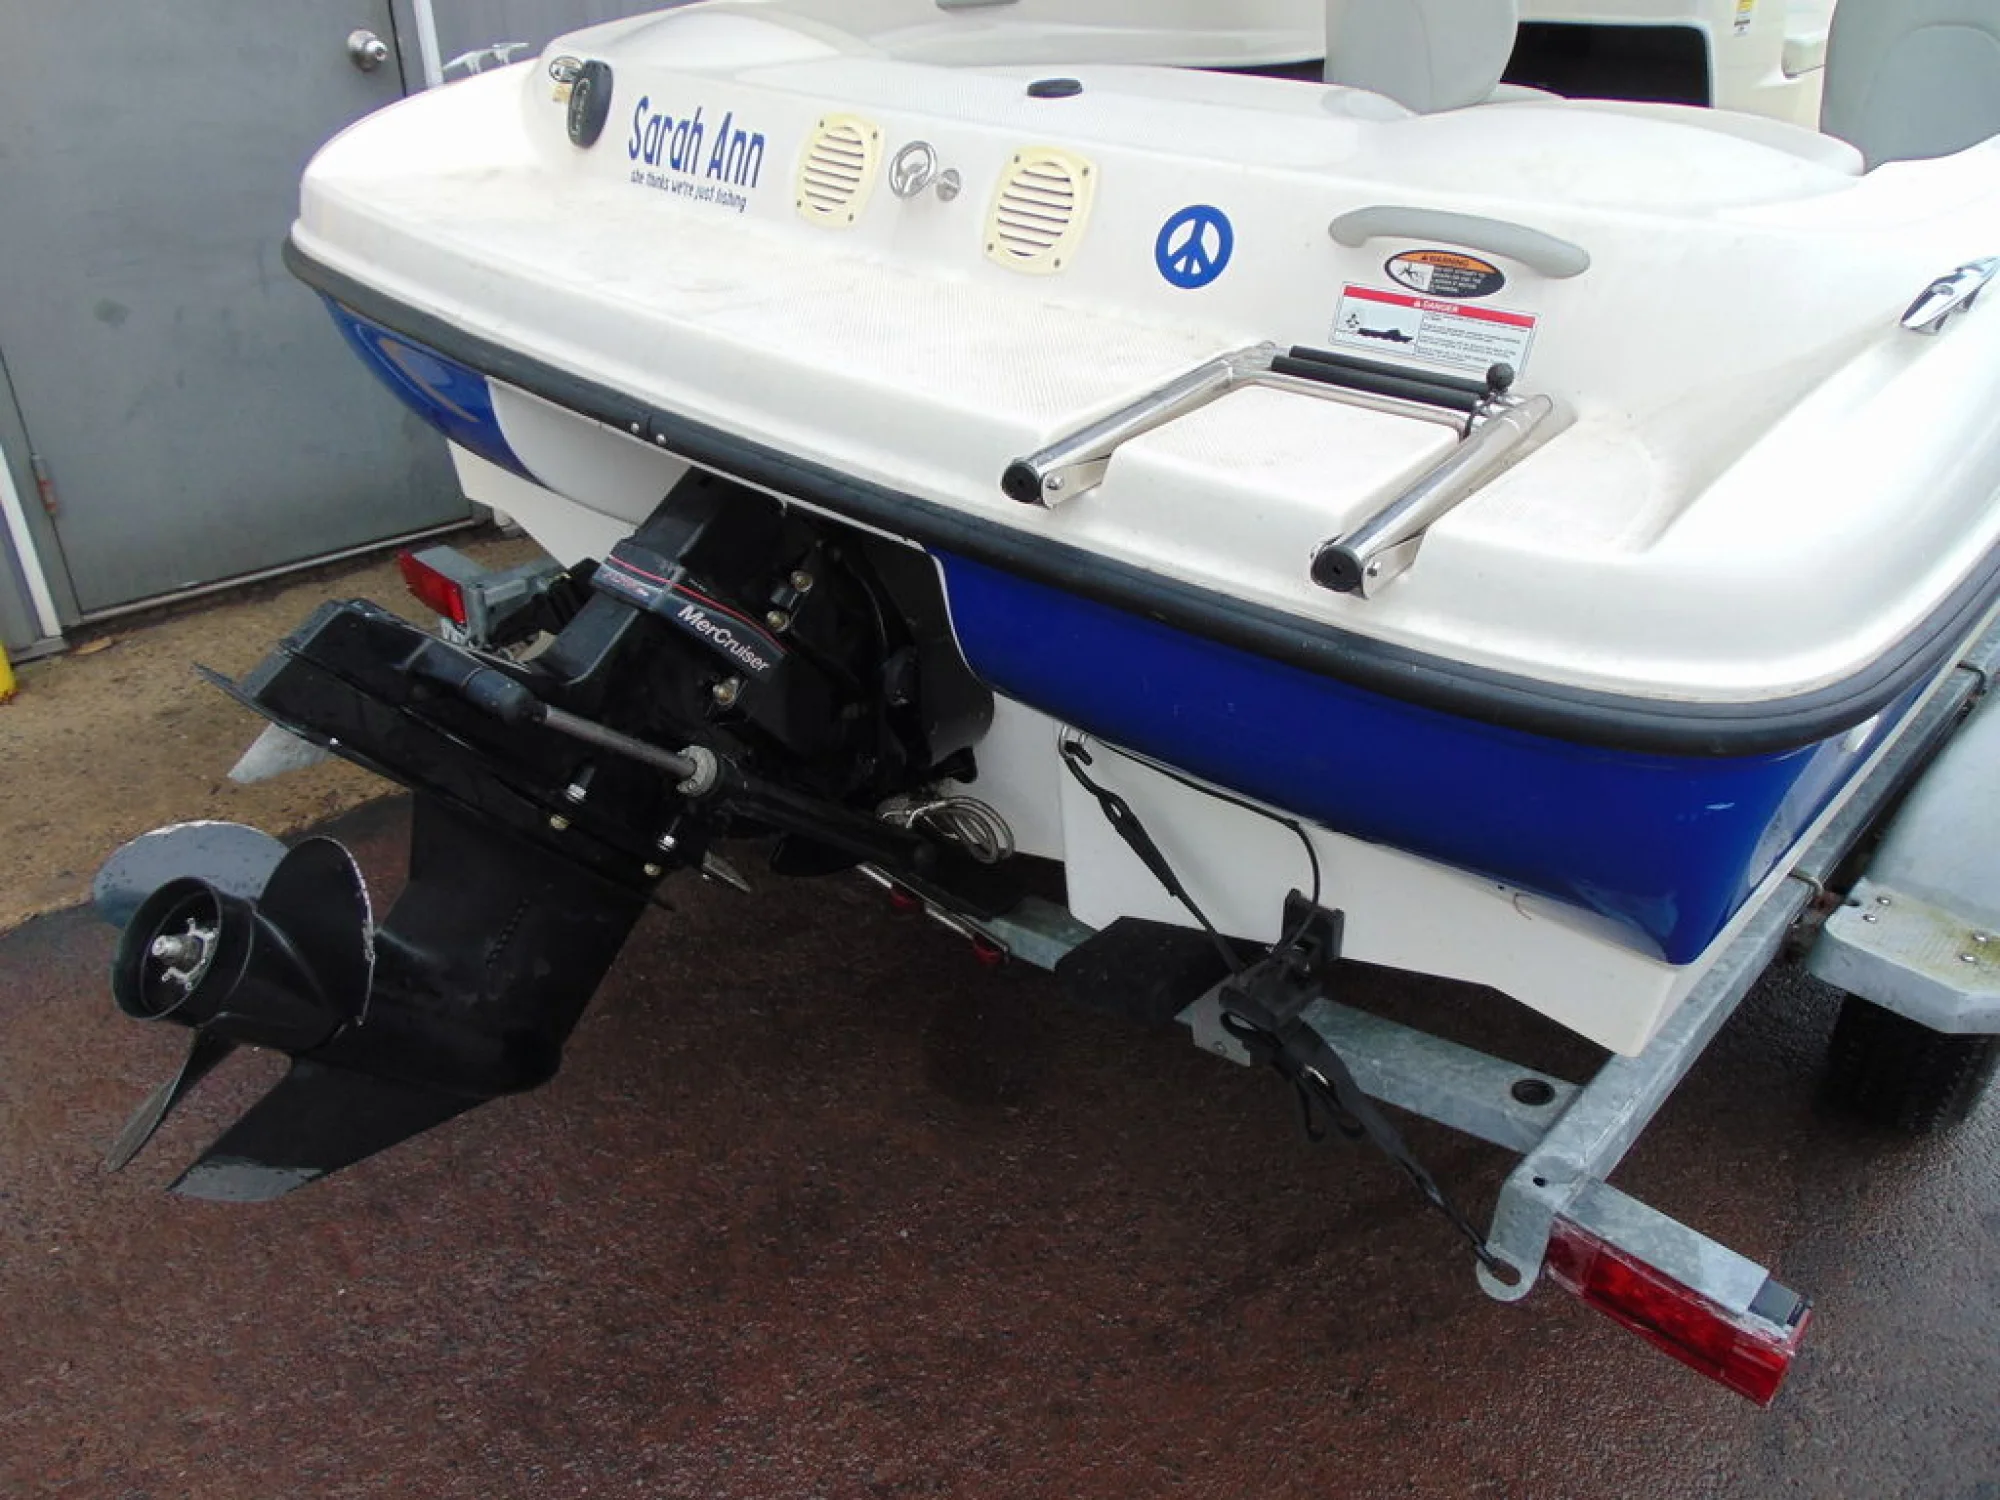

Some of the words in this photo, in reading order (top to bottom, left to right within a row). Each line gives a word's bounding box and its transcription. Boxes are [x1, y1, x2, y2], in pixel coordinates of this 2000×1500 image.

[628, 95, 704, 176] Sarah
[706, 111, 765, 188] Ann
[646, 172, 669, 192] thinks
[694, 185, 715, 202] just
[715, 188, 748, 213] fishing
[1429, 254, 1470, 266] WARNING
[1423, 299, 1460, 313] DANGER
[677, 604, 771, 673] MerCruiser
